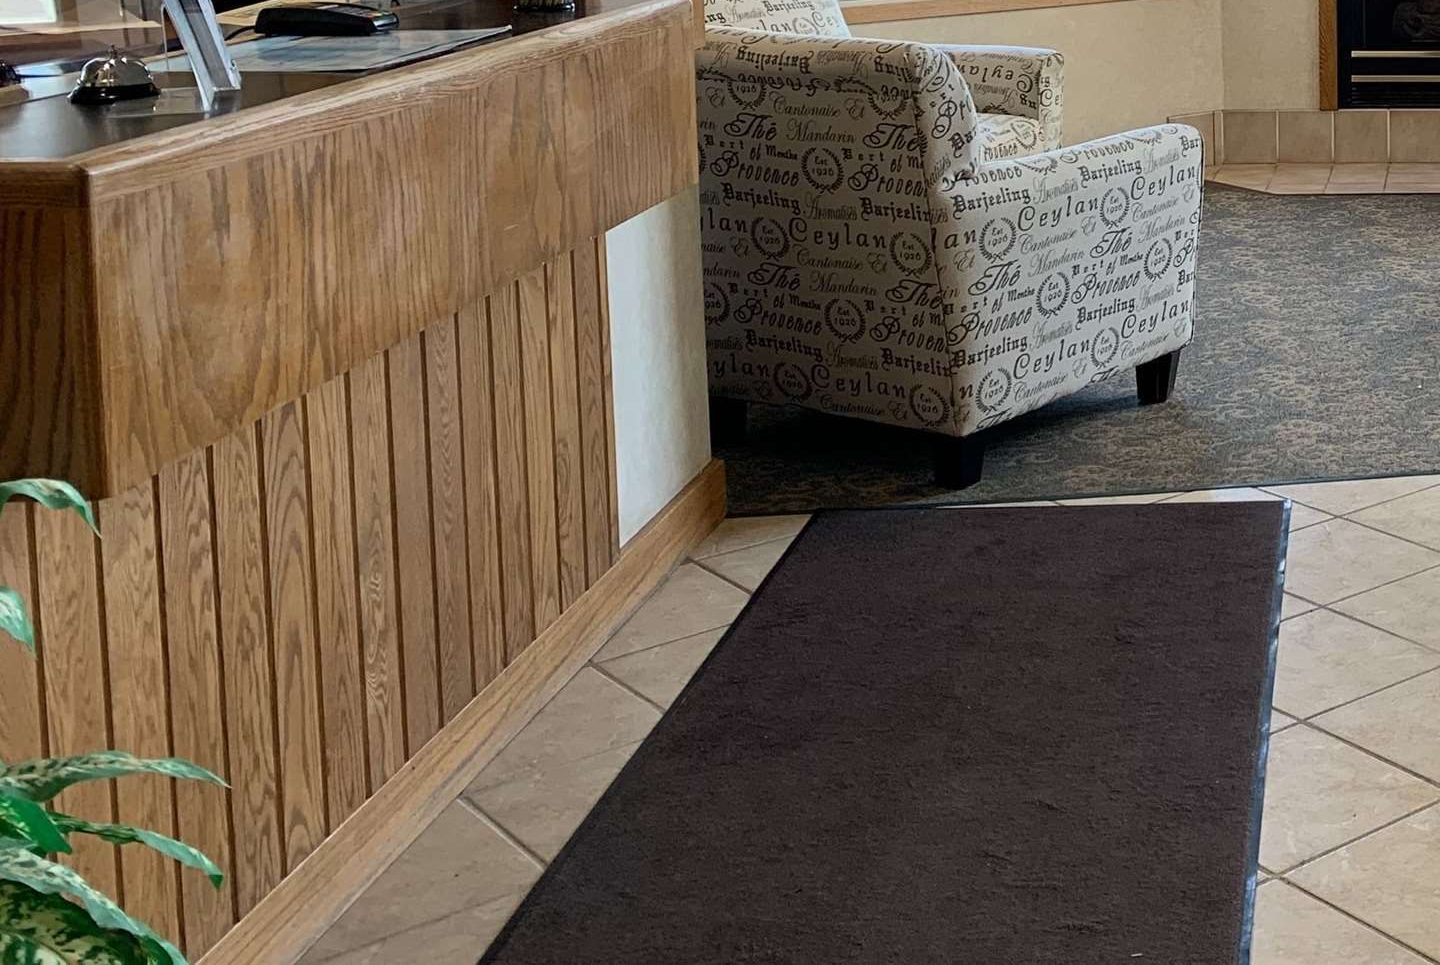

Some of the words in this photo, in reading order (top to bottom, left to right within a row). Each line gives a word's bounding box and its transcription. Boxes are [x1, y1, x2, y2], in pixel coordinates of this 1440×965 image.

[720, 182, 801, 216] Darjeeling
[950, 187, 1031, 220] Darjeeling
[1077, 159, 1143, 188] Darjeeling
[1017, 195, 1099, 231] Ceylan
[1131, 165, 1195, 200] Ceylan
[789, 217, 887, 250] Ceylan
[744, 329, 823, 363] Darjeeling
[950, 336, 1028, 369] Darjeeling
[1075, 298, 1135, 330] Darjeeling
[1013, 338, 1090, 380] Ceylan
[1121, 301, 1189, 339] Ceylan
[811, 364, 906, 401] Ceylan
